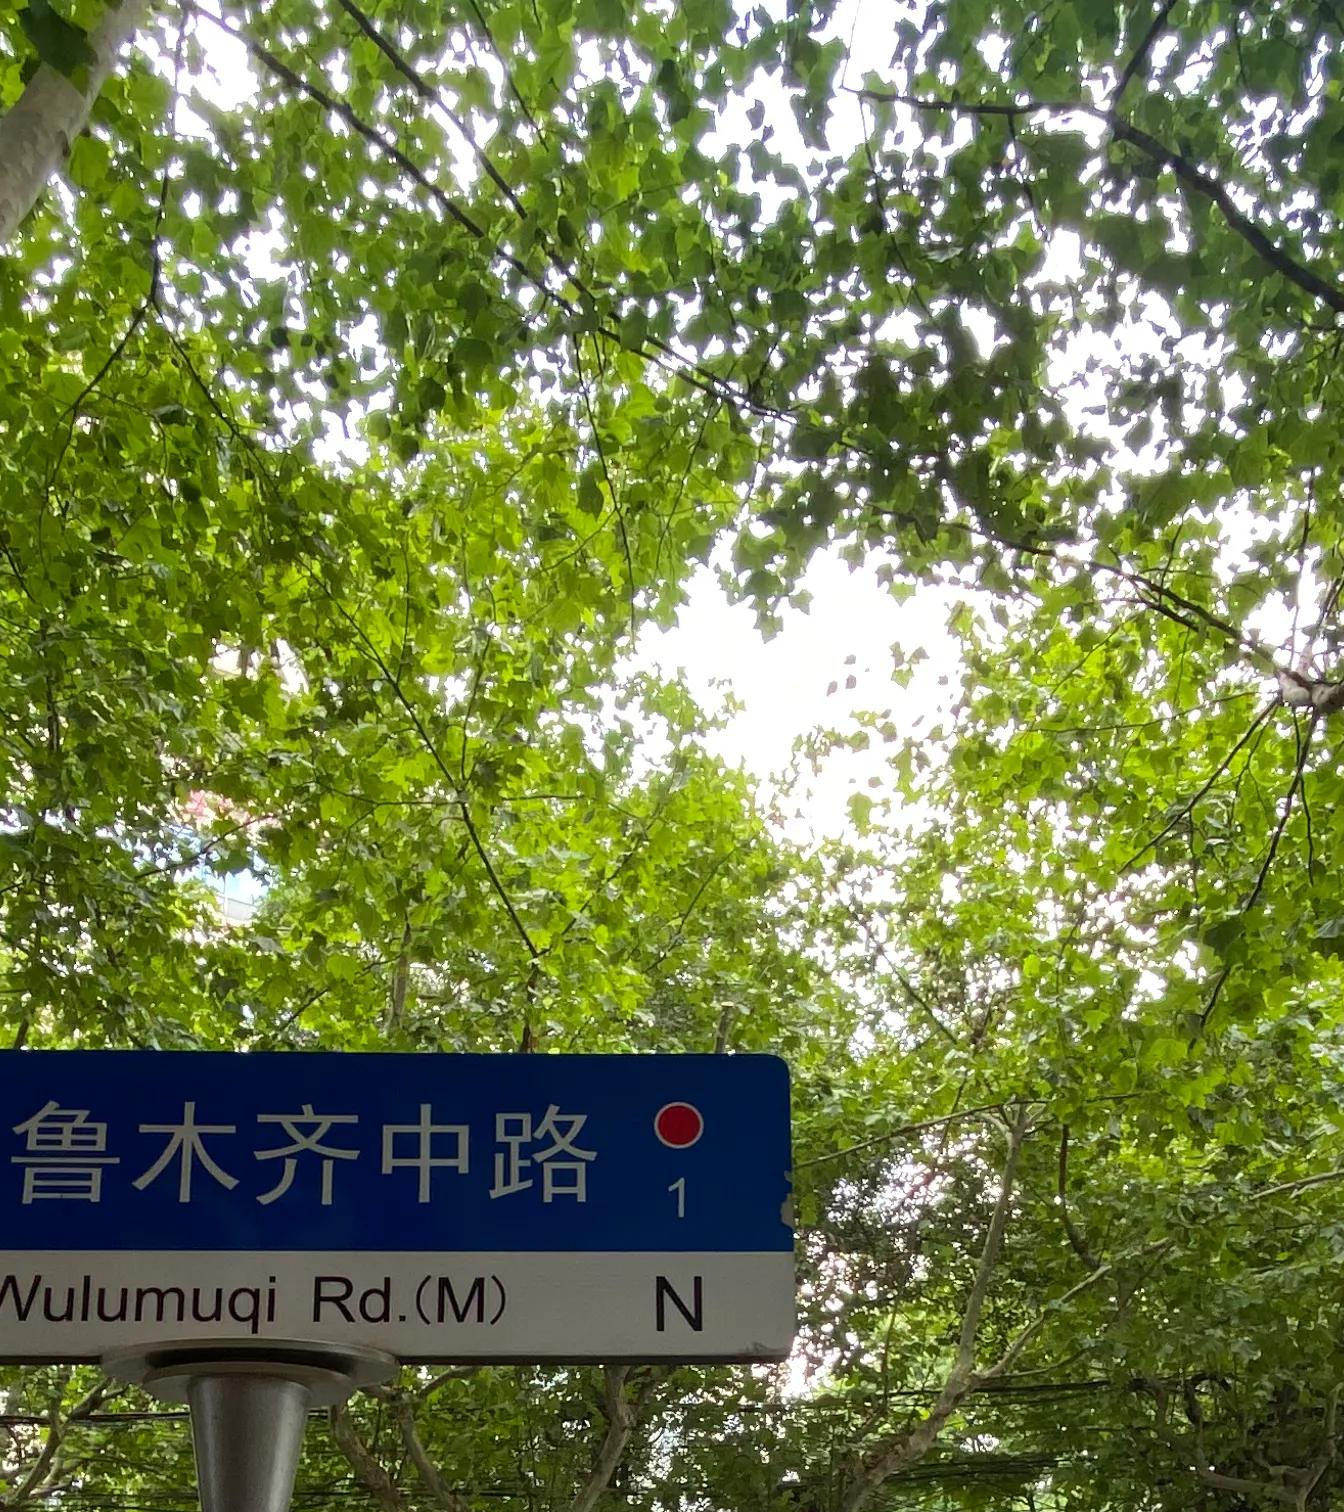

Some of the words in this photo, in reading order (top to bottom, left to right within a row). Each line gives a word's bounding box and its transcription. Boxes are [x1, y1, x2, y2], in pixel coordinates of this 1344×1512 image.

[669, 1178, 684, 1217] 1
[313, 1275, 505, 1325] Rd.(M)
[656, 1276, 702, 1331] N
